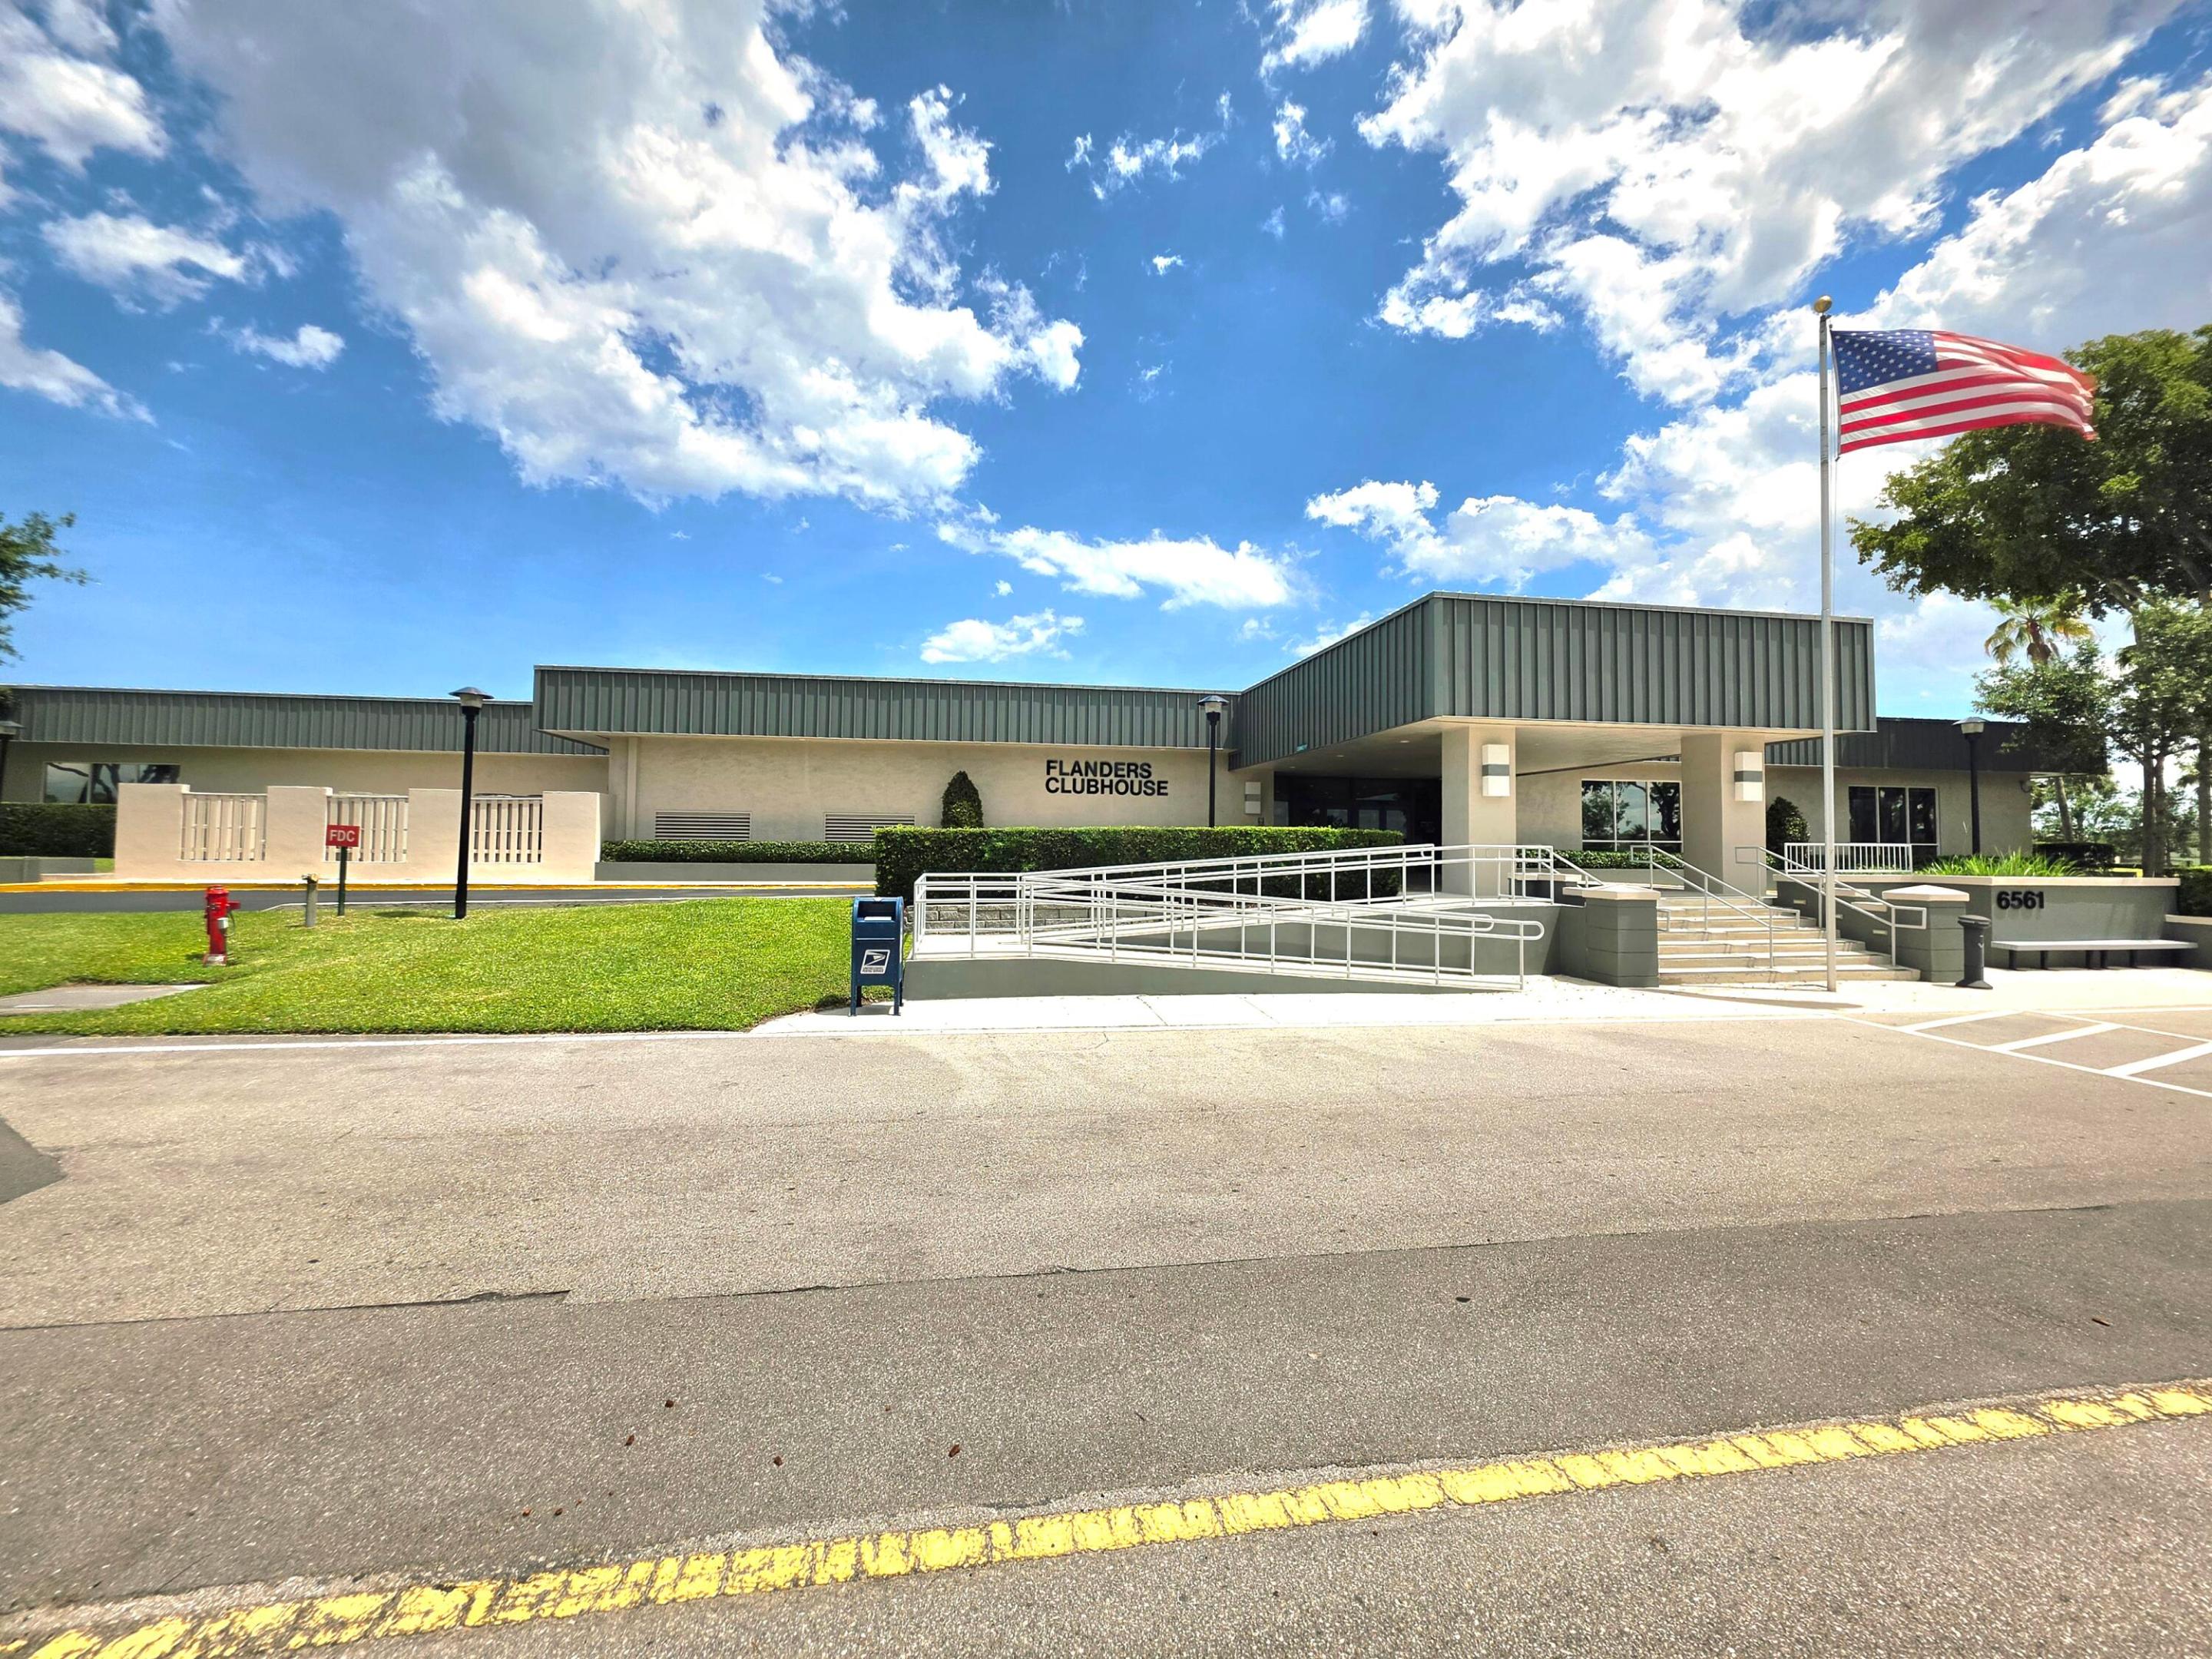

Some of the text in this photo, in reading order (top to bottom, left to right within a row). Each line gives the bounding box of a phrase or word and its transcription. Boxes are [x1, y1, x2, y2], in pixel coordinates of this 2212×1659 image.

[1046, 760, 1152, 779] FLANDERS
[1045, 777, 1168, 796] CLUBHOUSE
[329, 830, 356, 843] FDC
[1997, 890, 2044, 909] 6561
